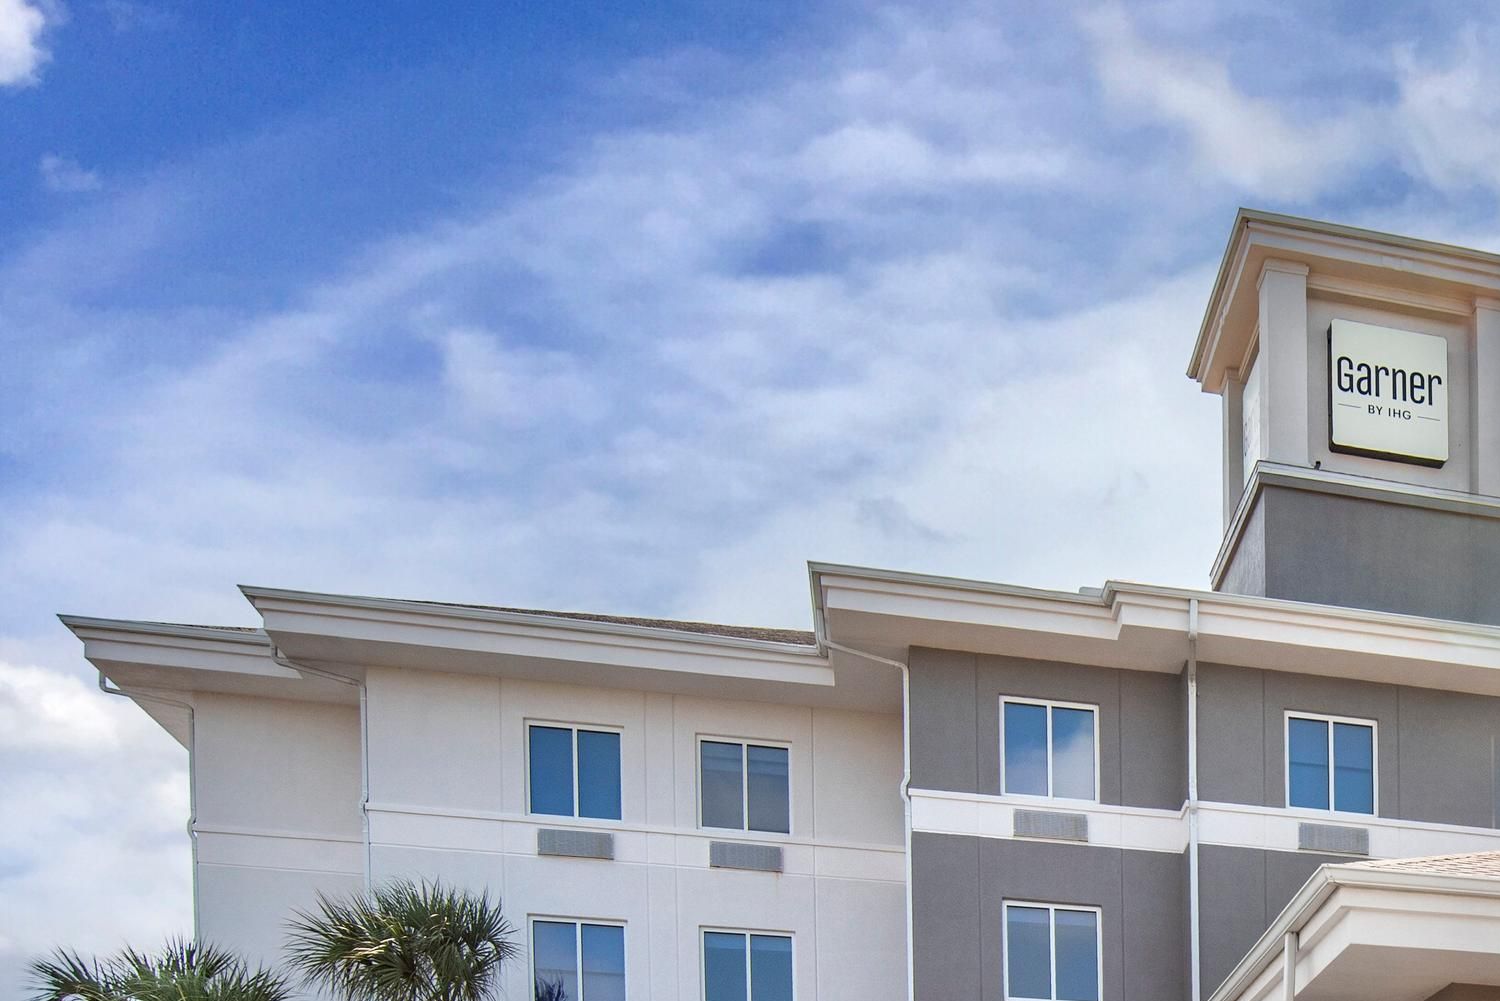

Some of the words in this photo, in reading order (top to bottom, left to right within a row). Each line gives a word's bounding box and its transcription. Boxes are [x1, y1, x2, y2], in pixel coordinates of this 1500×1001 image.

[1337, 356, 1442, 406] Garner
[1368, 404, 1383, 415] BY
[1388, 407, 1412, 420] IHG
